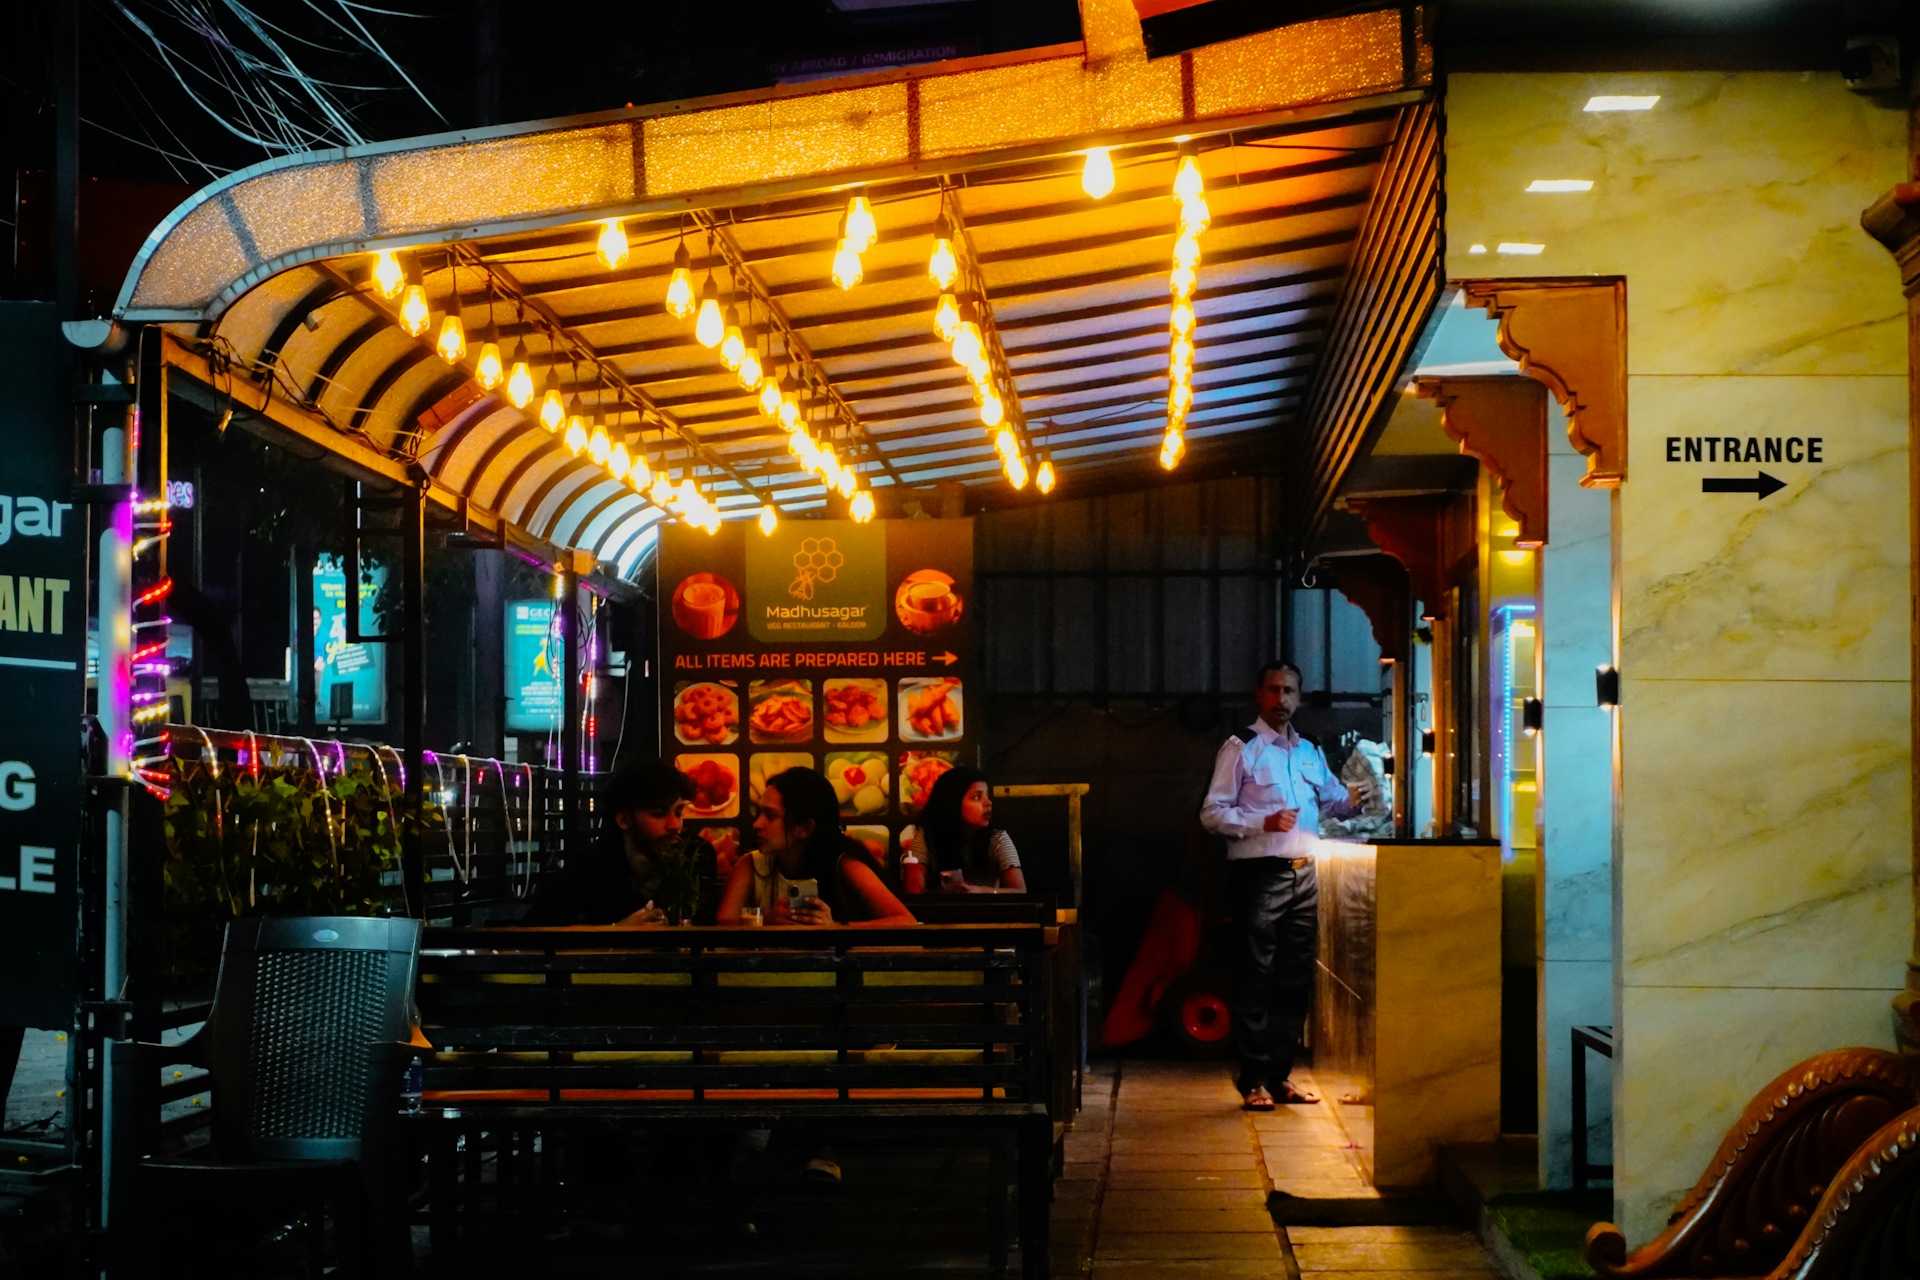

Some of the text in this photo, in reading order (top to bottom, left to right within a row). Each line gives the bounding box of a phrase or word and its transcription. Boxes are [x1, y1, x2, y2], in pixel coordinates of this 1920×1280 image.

[791, 56, 847, 73] ABROAD
[862, 44, 957, 65] IMMIGRATION
[1666, 437, 1823, 462] ENTRANCE
[0, 575, 70, 635] ANT
[766, 605, 866, 620] Madhusagar
[766, 622, 782, 630] VEG
[783, 621, 830, 630] RESTAURANT
[675, 651, 926, 669] ALL ITEMS ARE PREPARED HERE
